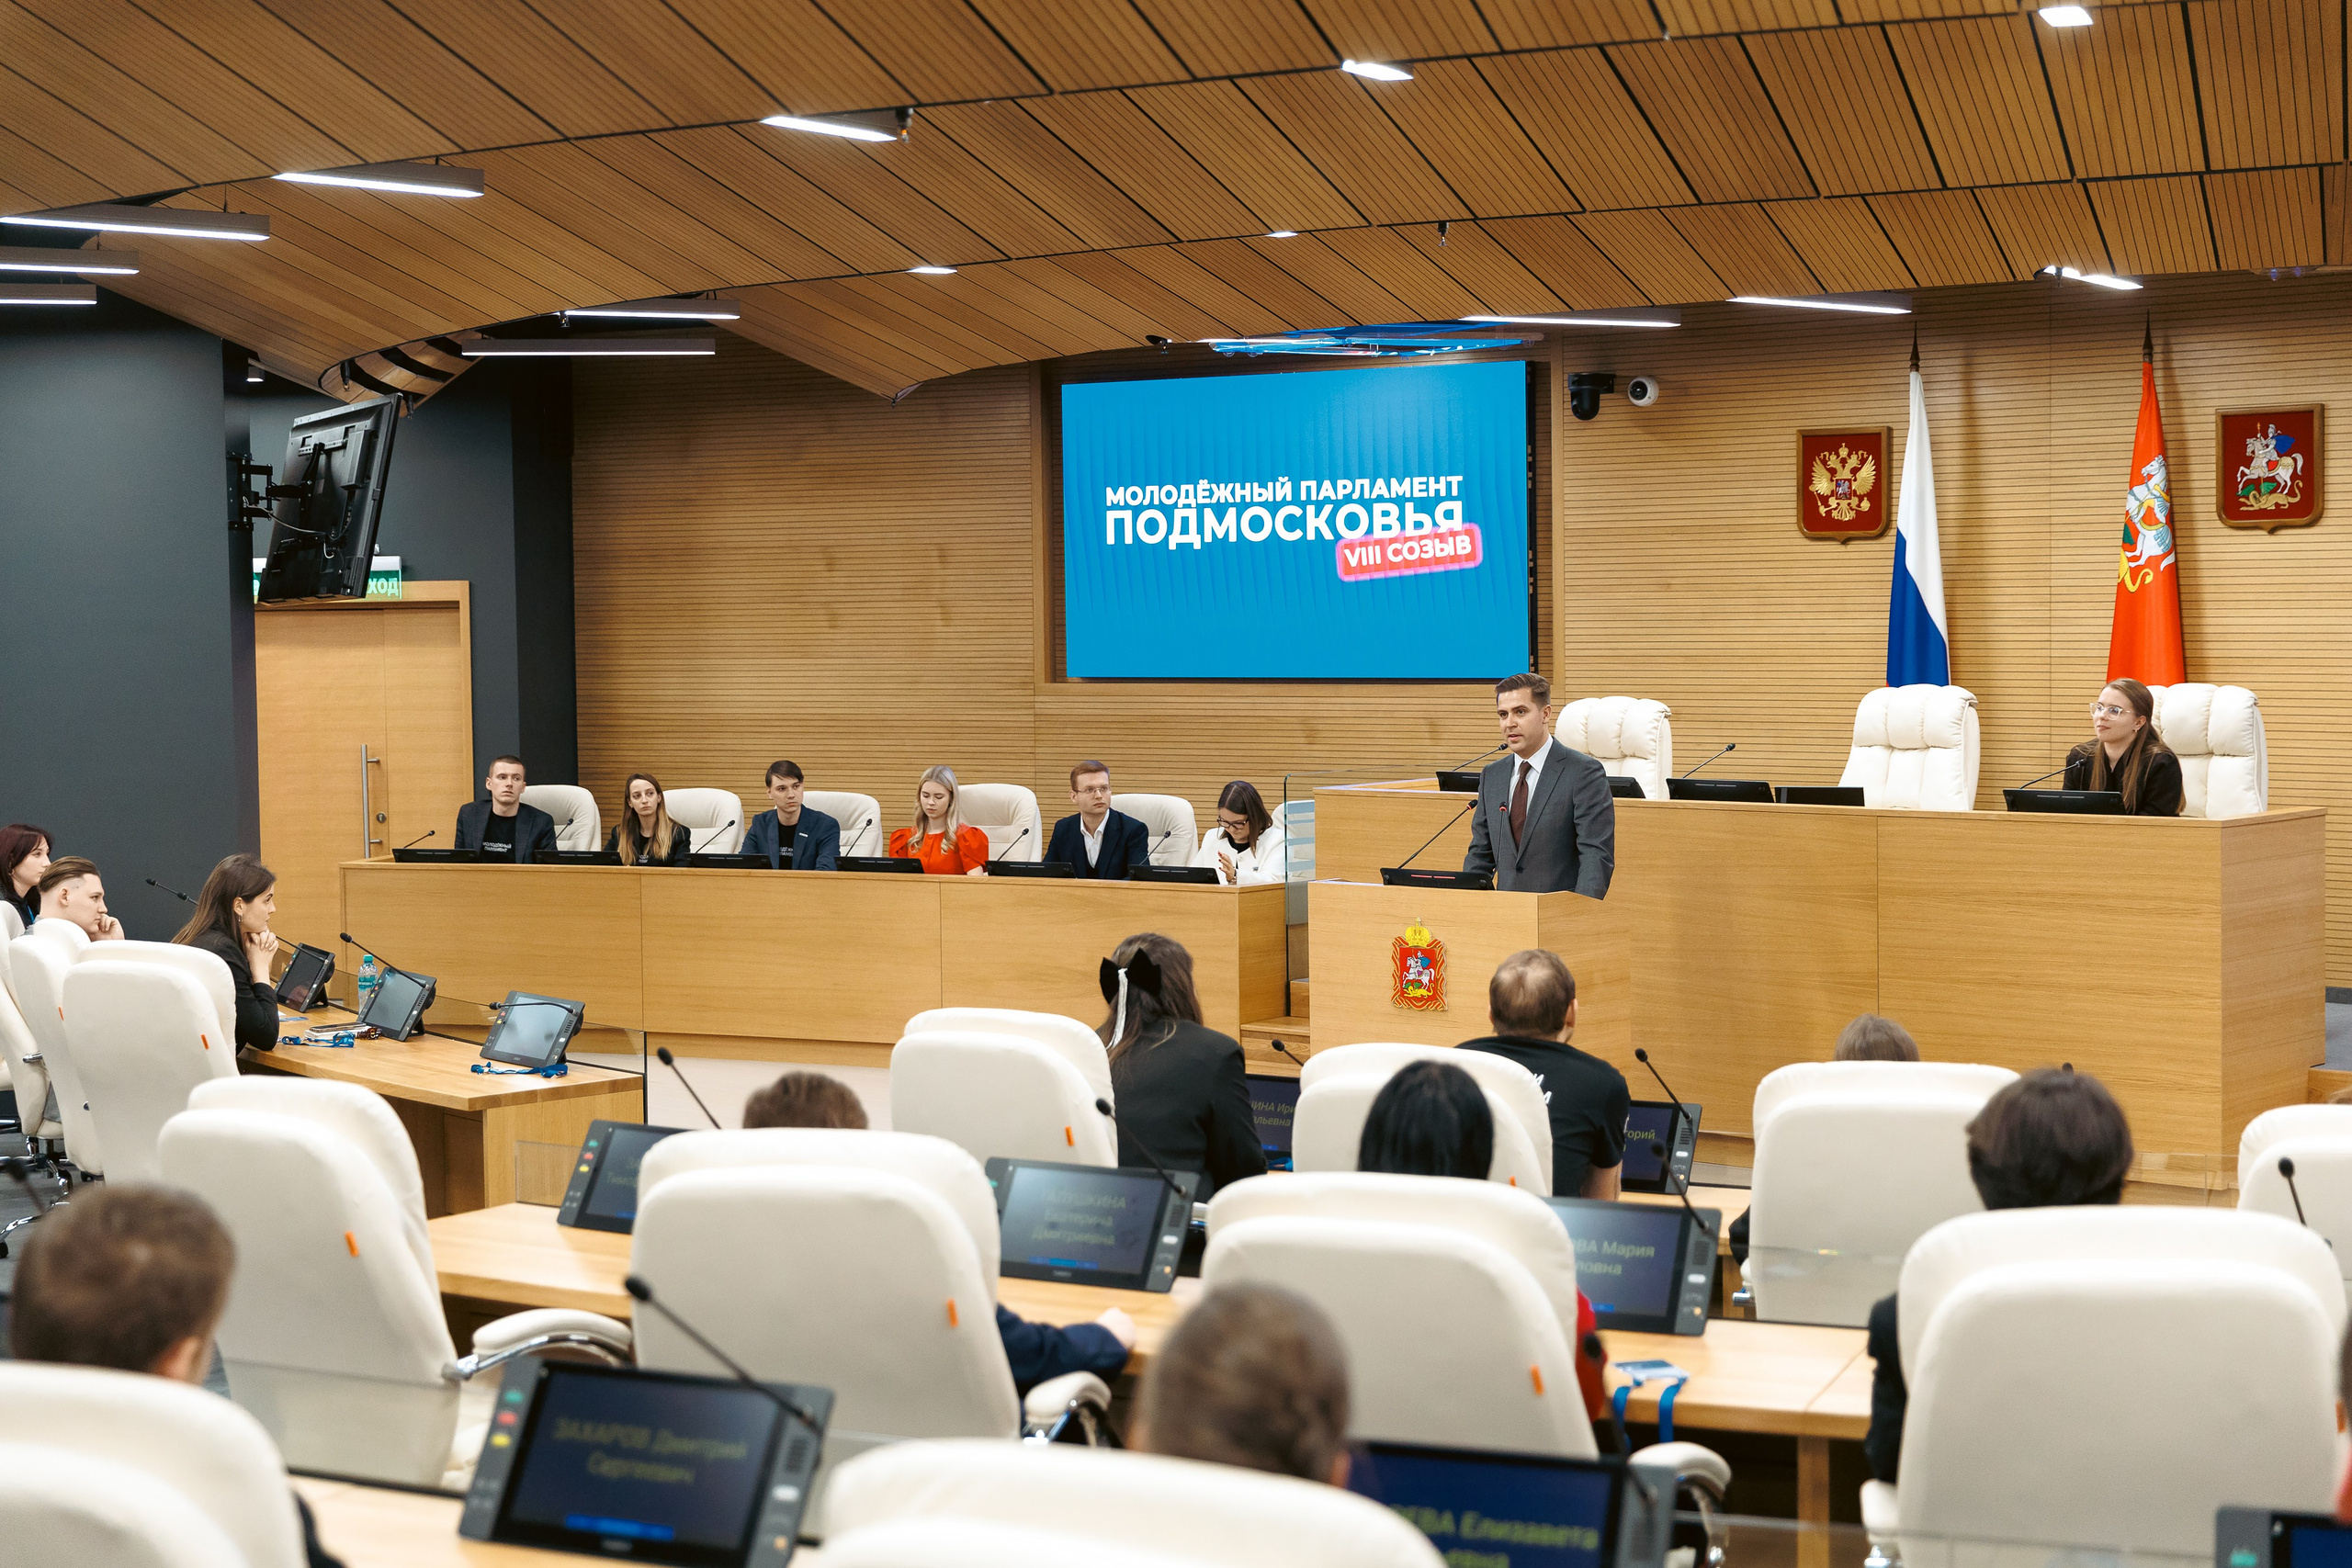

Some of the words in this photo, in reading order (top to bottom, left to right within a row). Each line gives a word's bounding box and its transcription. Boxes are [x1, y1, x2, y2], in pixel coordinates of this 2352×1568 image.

[1105, 477, 1292, 508] МОЛОДЁЖНЫЙ
[1300, 476, 1463, 502] ПАРЛАМЕНТ
[1105, 501, 1463, 550] ПОДМОСКОВЬЯ
[1344, 545, 1382, 568] VIII
[1386, 535, 1472, 563] СОЗЫВ
[1601, 1240, 1655, 1259] Мария
